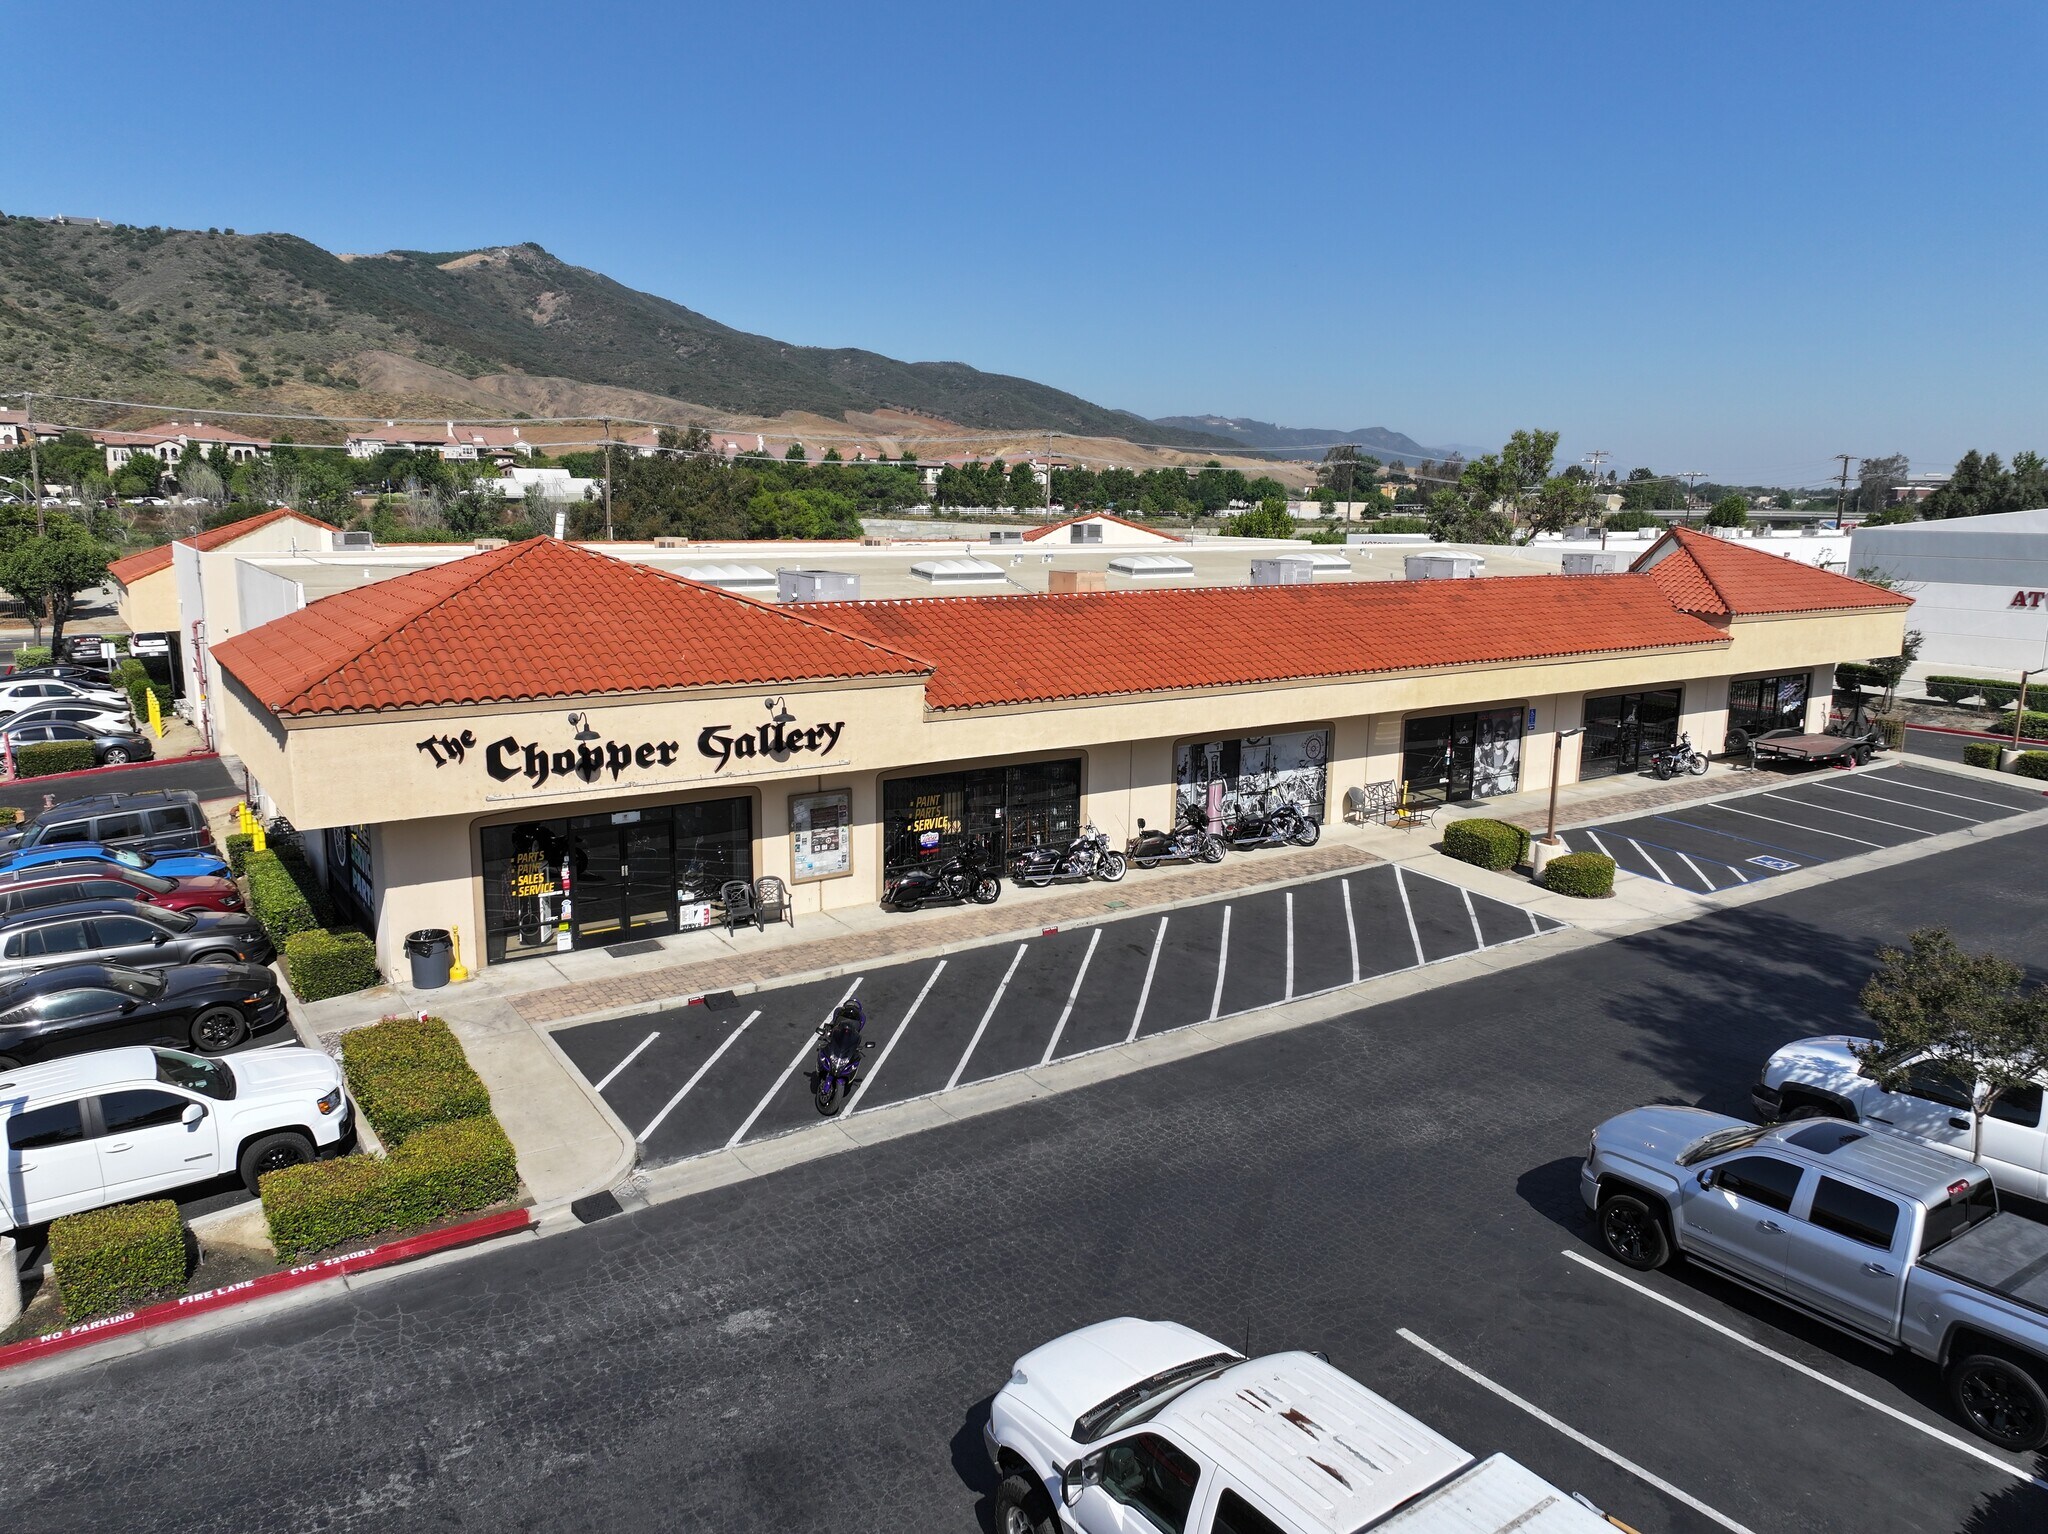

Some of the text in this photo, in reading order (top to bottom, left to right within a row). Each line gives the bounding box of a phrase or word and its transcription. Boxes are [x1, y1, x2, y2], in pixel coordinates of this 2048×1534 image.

[416, 721, 845, 789] The Chopper Gallery
[916, 795, 940, 808] PAINT
[915, 806, 941, 819] PARTS
[913, 816, 948, 832] SERVICE
[517, 851, 544, 863] PARTS
[518, 872, 545, 886] SALES
[518, 882, 555, 897] SERVICE
[290, 1263, 319, 1275] CVC
[178, 1280, 255, 1306] FIRE LANE
[40, 1311, 136, 1343] NO PARKING
